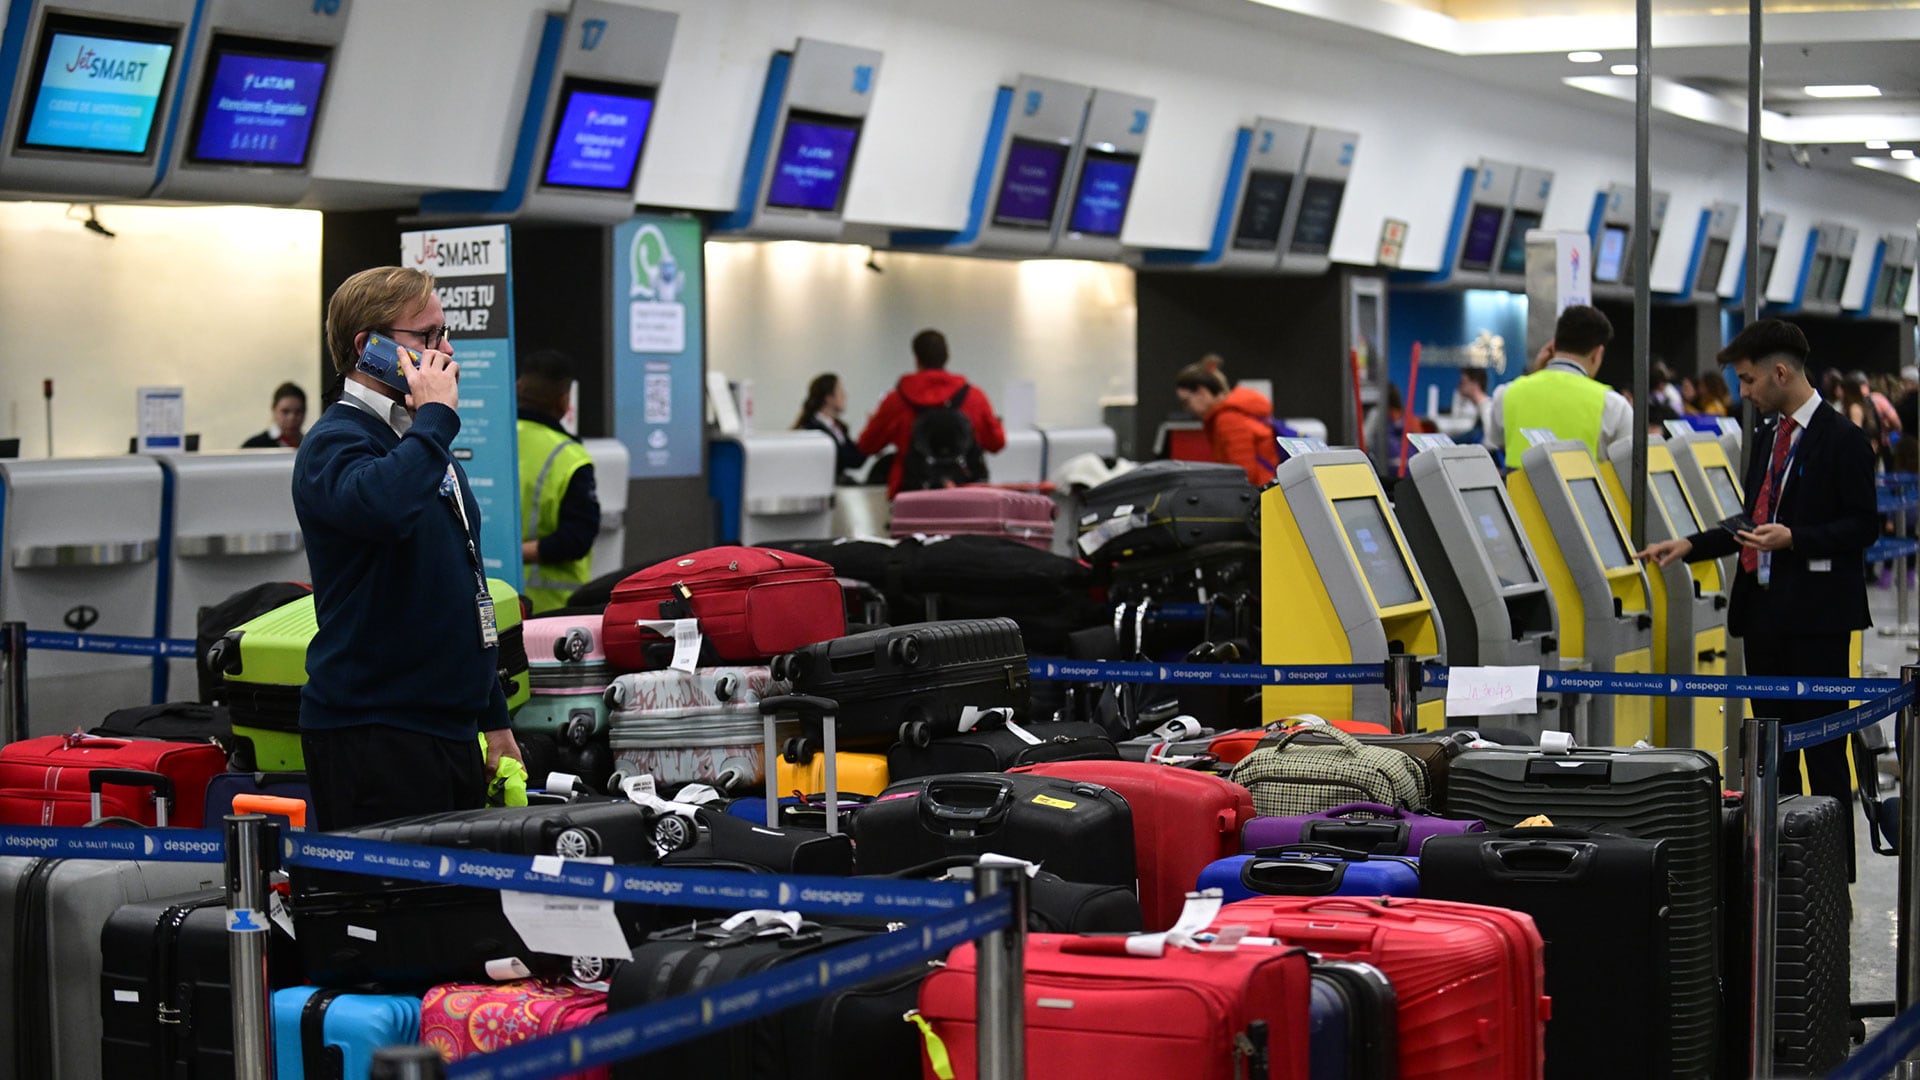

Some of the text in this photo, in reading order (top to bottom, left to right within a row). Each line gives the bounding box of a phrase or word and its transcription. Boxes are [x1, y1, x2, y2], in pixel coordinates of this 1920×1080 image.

[581, 19, 608, 51] 17
[66, 45, 149, 83] JetSMART
[415, 233, 490, 267] JetSMART
[433, 284, 495, 309] GASTE TU
[1061, 666, 1099, 676] despegar
[1173, 669, 1213, 680] despegar
[1288, 670, 1328, 681] despegar
[1561, 677, 1603, 688] despegar
[1624, 681, 1642, 689] SALUT
[1645, 682, 1663, 690] HALLO
[1685, 681, 1728, 692] despegar
[1812, 684, 1856, 695] despegar
[5, 835, 59, 850] despegar
[85, 841, 108, 850] SALUT
[111, 842, 135, 850] HALLO
[163, 839, 220, 855] despegar
[302, 844, 355, 862] despegar
[459, 862, 515, 880] despegar
[624, 877, 683, 896] despegar
[800, 888, 864, 906] despegar
